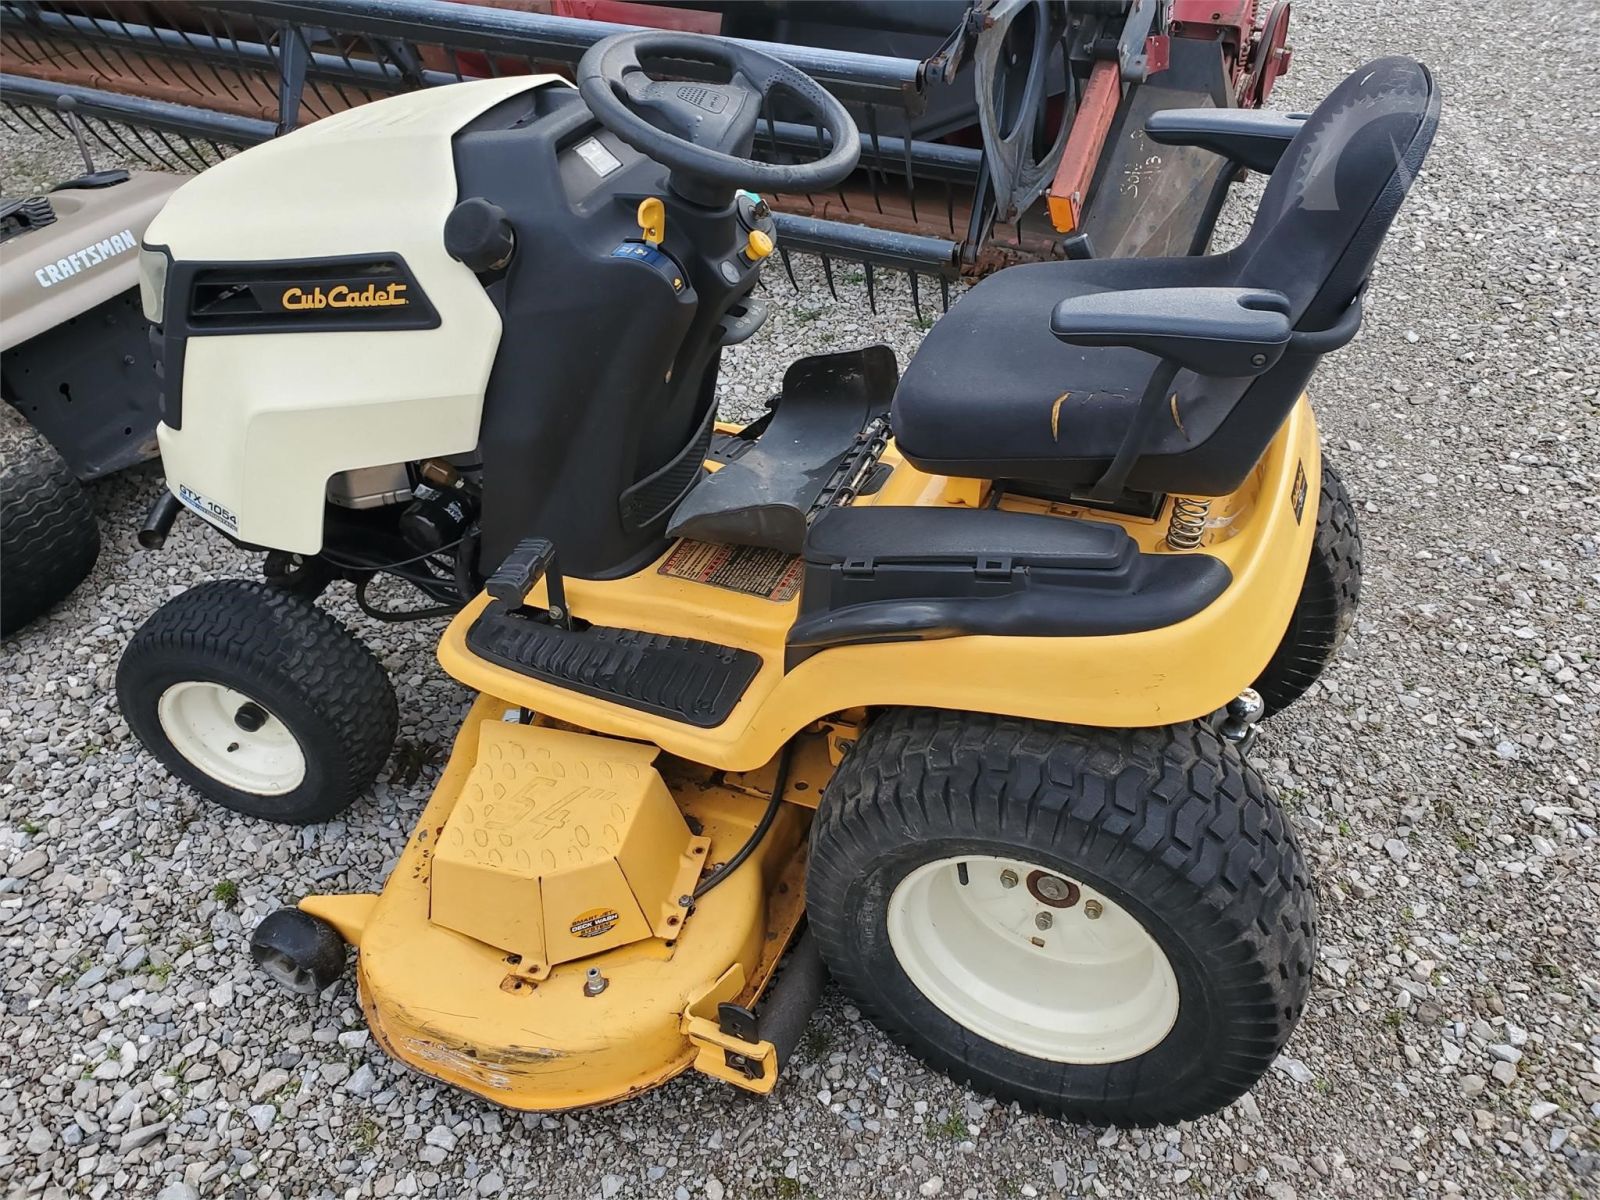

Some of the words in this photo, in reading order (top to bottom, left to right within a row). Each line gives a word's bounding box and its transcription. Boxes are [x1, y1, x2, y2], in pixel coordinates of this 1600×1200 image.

[35, 229, 137, 288] CRAFTSMAN
[282, 287, 327, 310] Cub
[328, 283, 407, 308] Cadet
[180, 484, 202, 505] GTX
[207, 502, 237, 525] 1054
[571, 922, 593, 932] DECK
[594, 914, 618, 925] WASH
